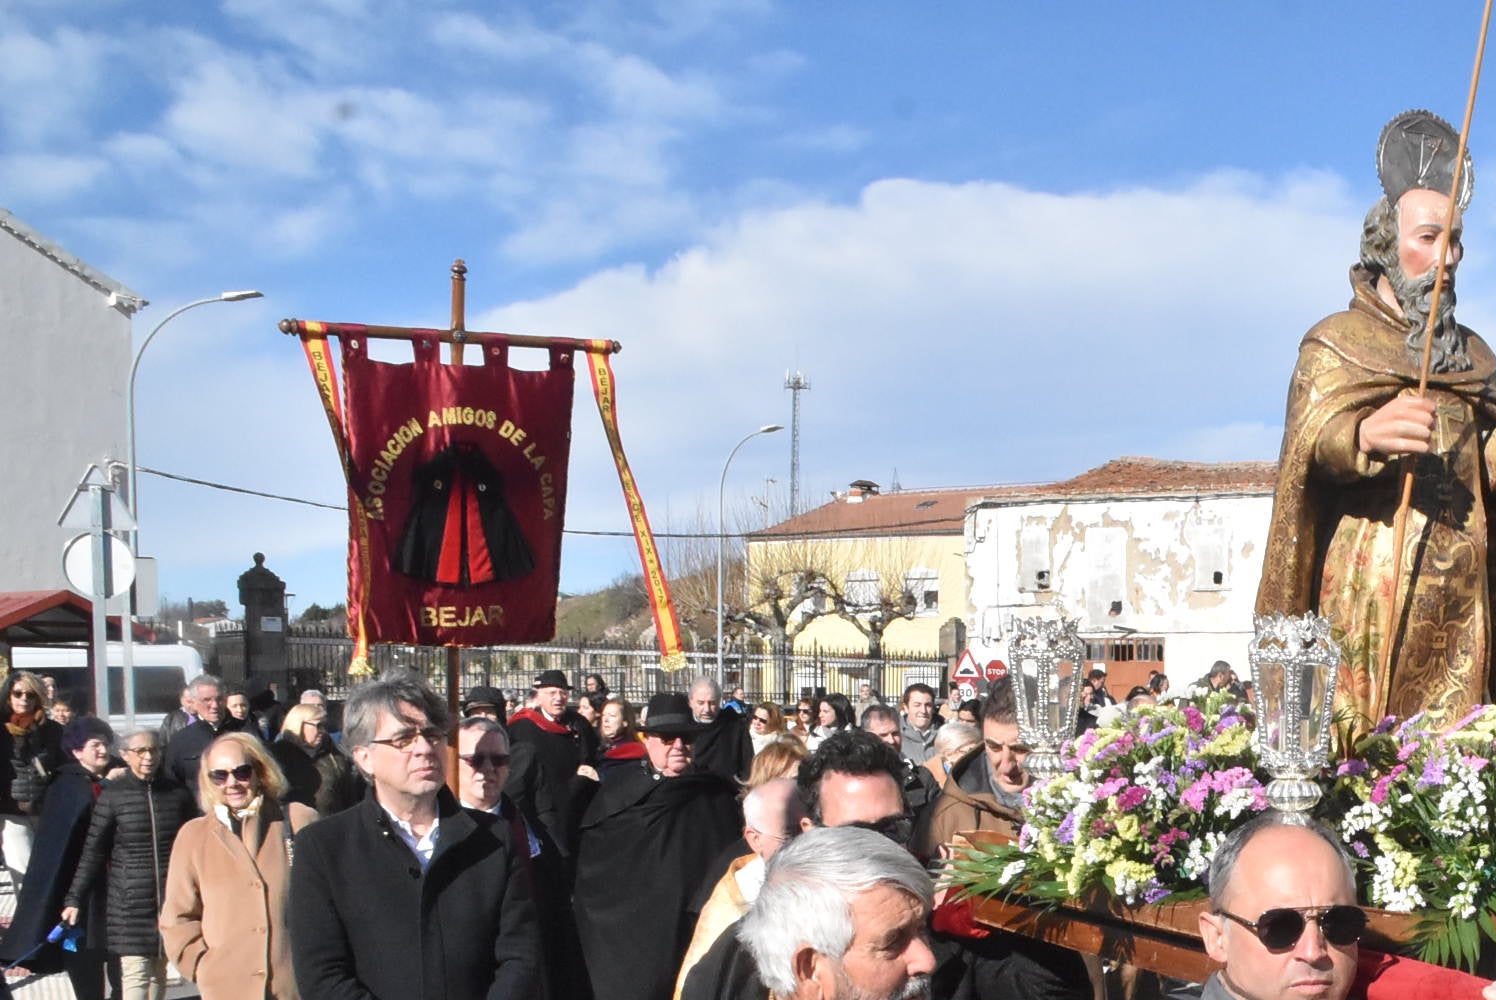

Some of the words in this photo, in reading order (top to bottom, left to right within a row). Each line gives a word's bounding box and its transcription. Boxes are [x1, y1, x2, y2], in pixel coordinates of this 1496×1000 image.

[365, 417, 424, 520] ASOCIACION
[428, 406, 497, 429] AMIGOS
[498, 420, 527, 446] DE
[523, 442, 546, 470] LA
[540, 473, 556, 520] CAPA
[420, 605, 504, 627] BEJAR
[987, 668, 1005, 676] STOP
[959, 688, 972, 697] 30
